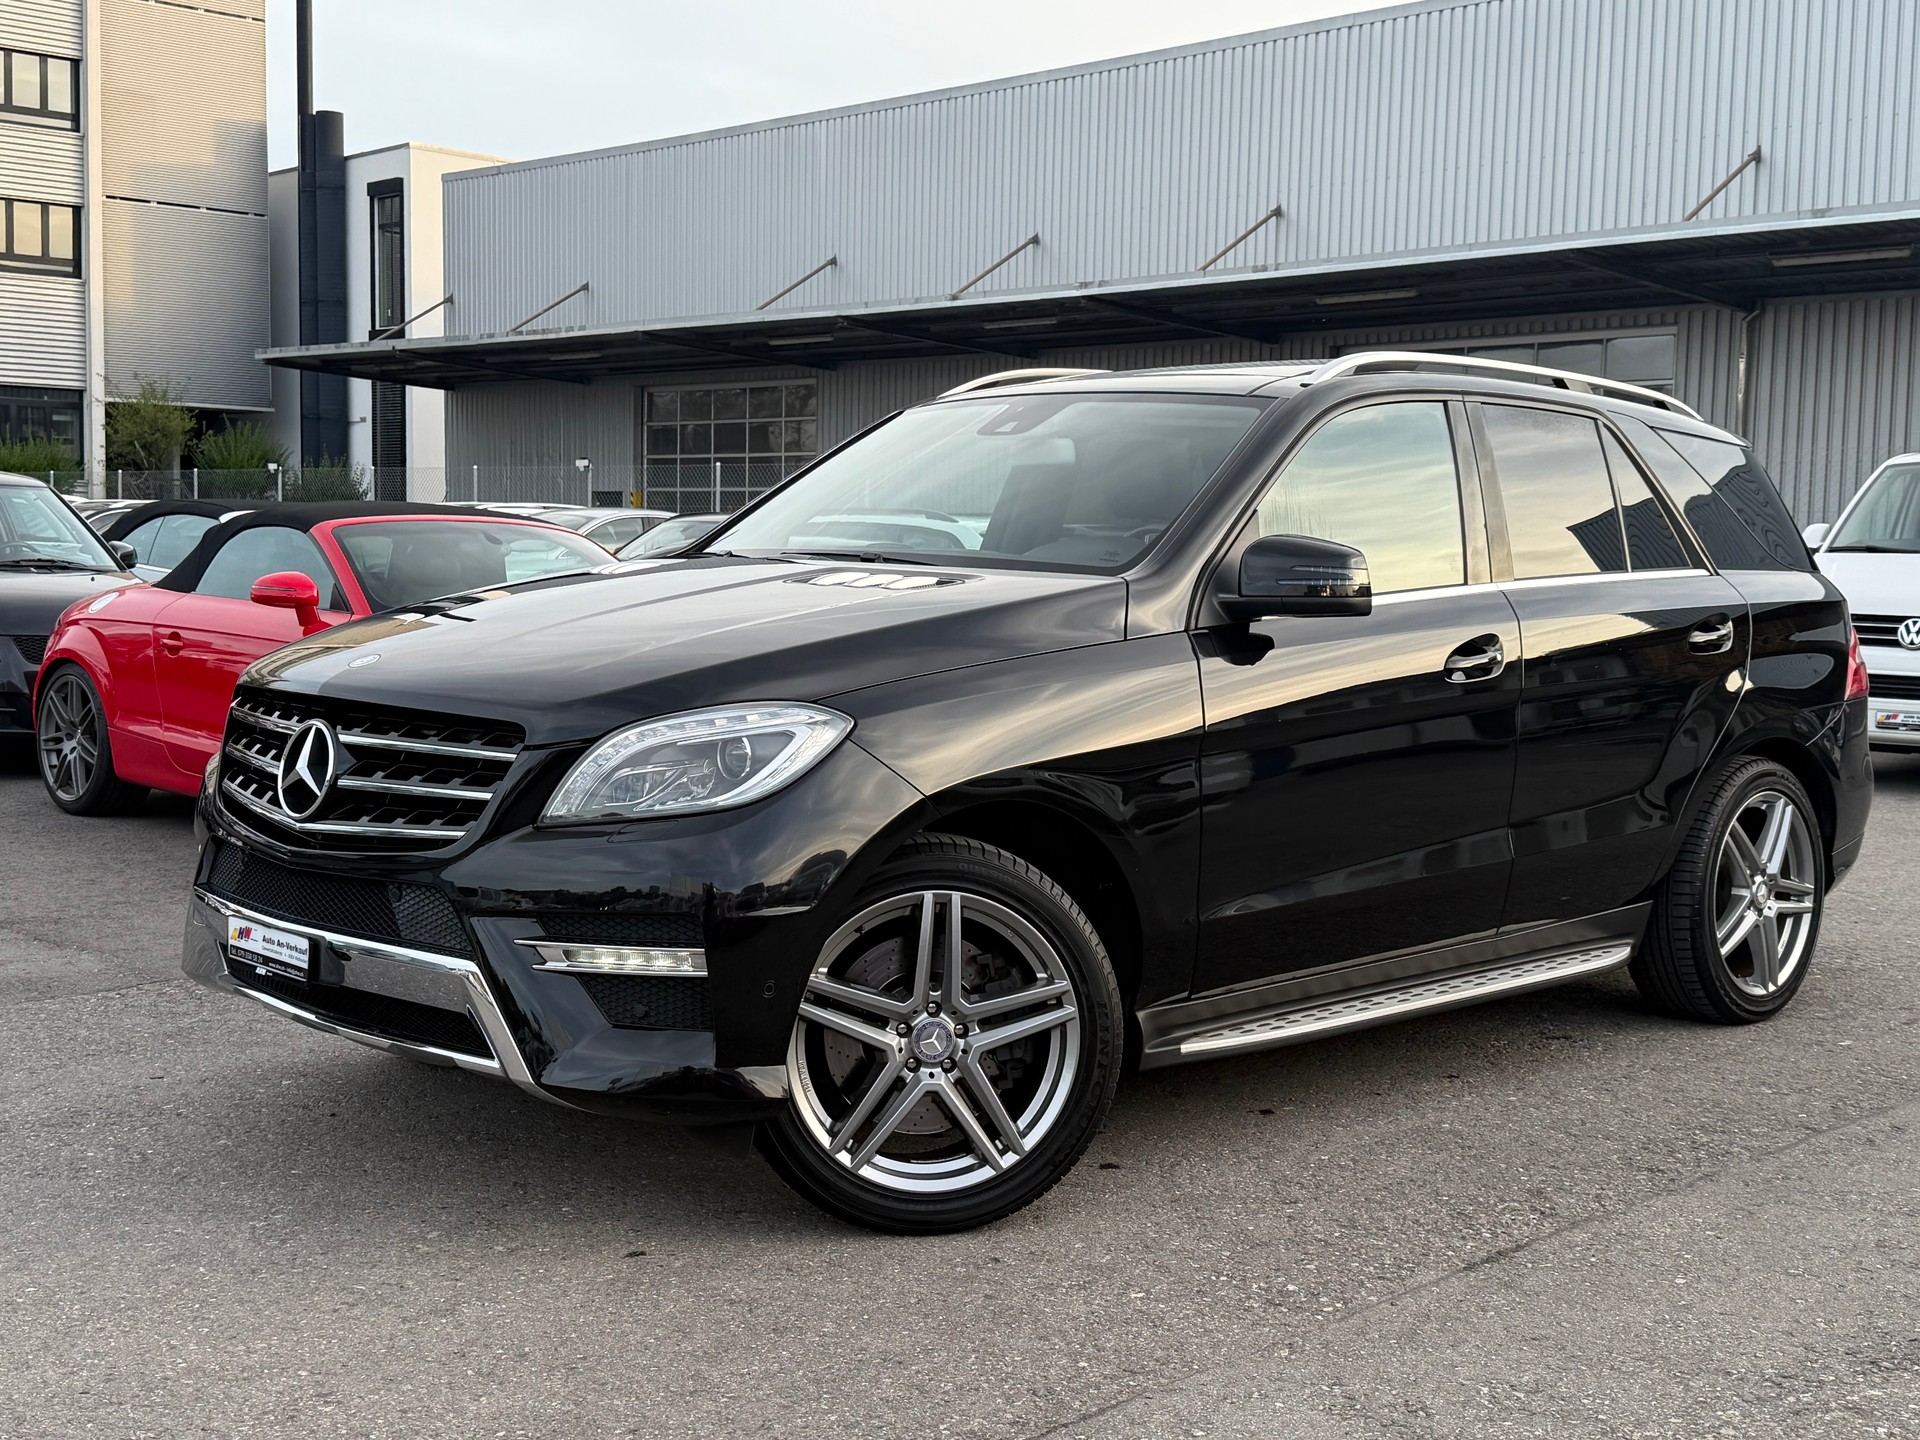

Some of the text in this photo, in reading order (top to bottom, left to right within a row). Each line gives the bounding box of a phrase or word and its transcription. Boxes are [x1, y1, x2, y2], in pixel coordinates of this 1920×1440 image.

[231, 926, 252, 941] AHW
[263, 935, 307, 956] Auto An-Verkauf
